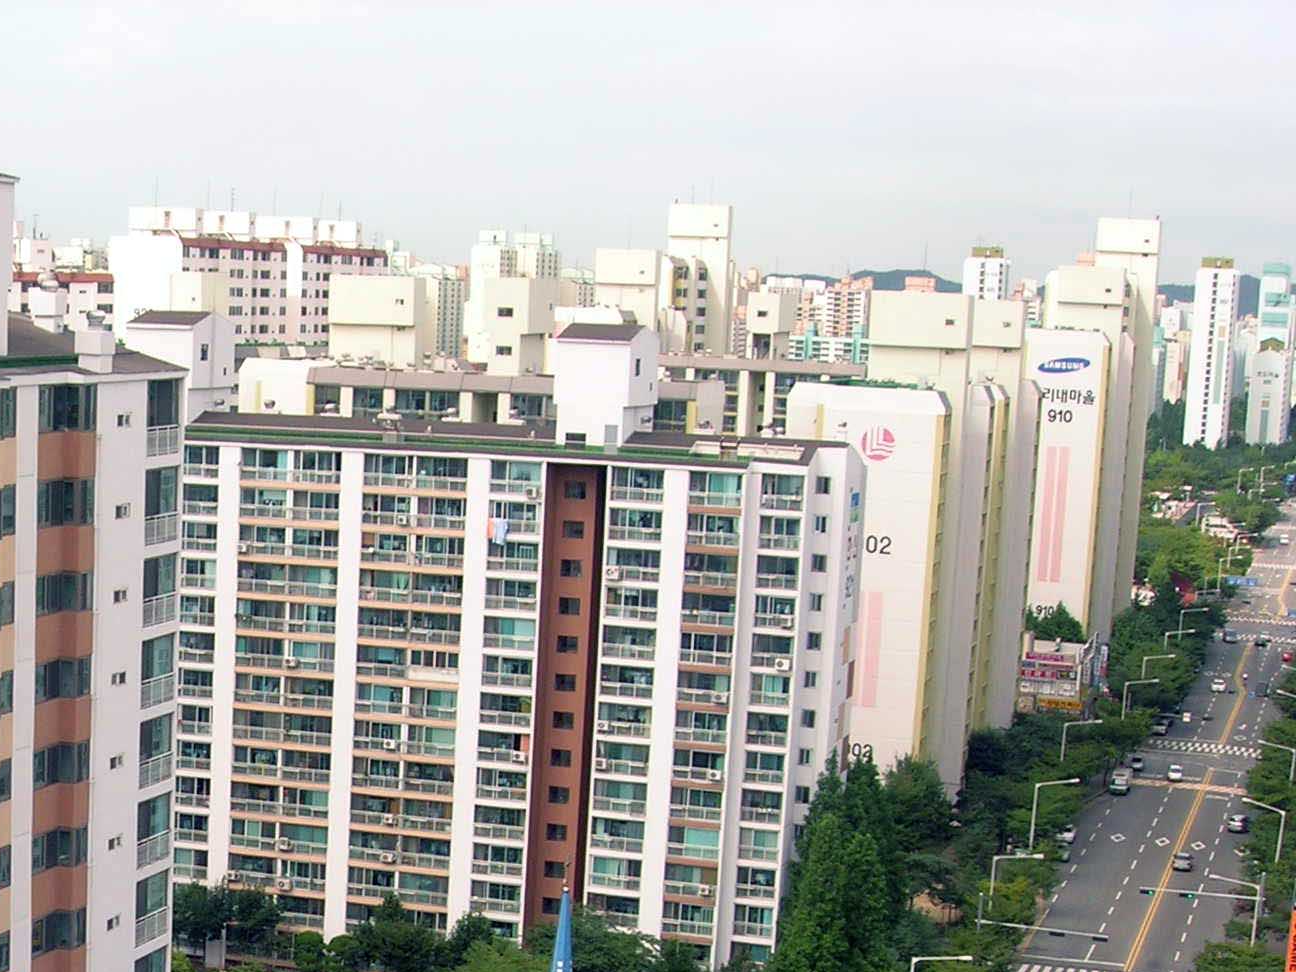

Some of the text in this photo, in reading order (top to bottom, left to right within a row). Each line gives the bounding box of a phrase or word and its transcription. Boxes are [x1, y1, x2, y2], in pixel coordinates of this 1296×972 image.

[1042, 359, 1087, 371] SAMSUNG
[1048, 408, 1073, 423] 910
[1035, 604, 1055, 617] 910
